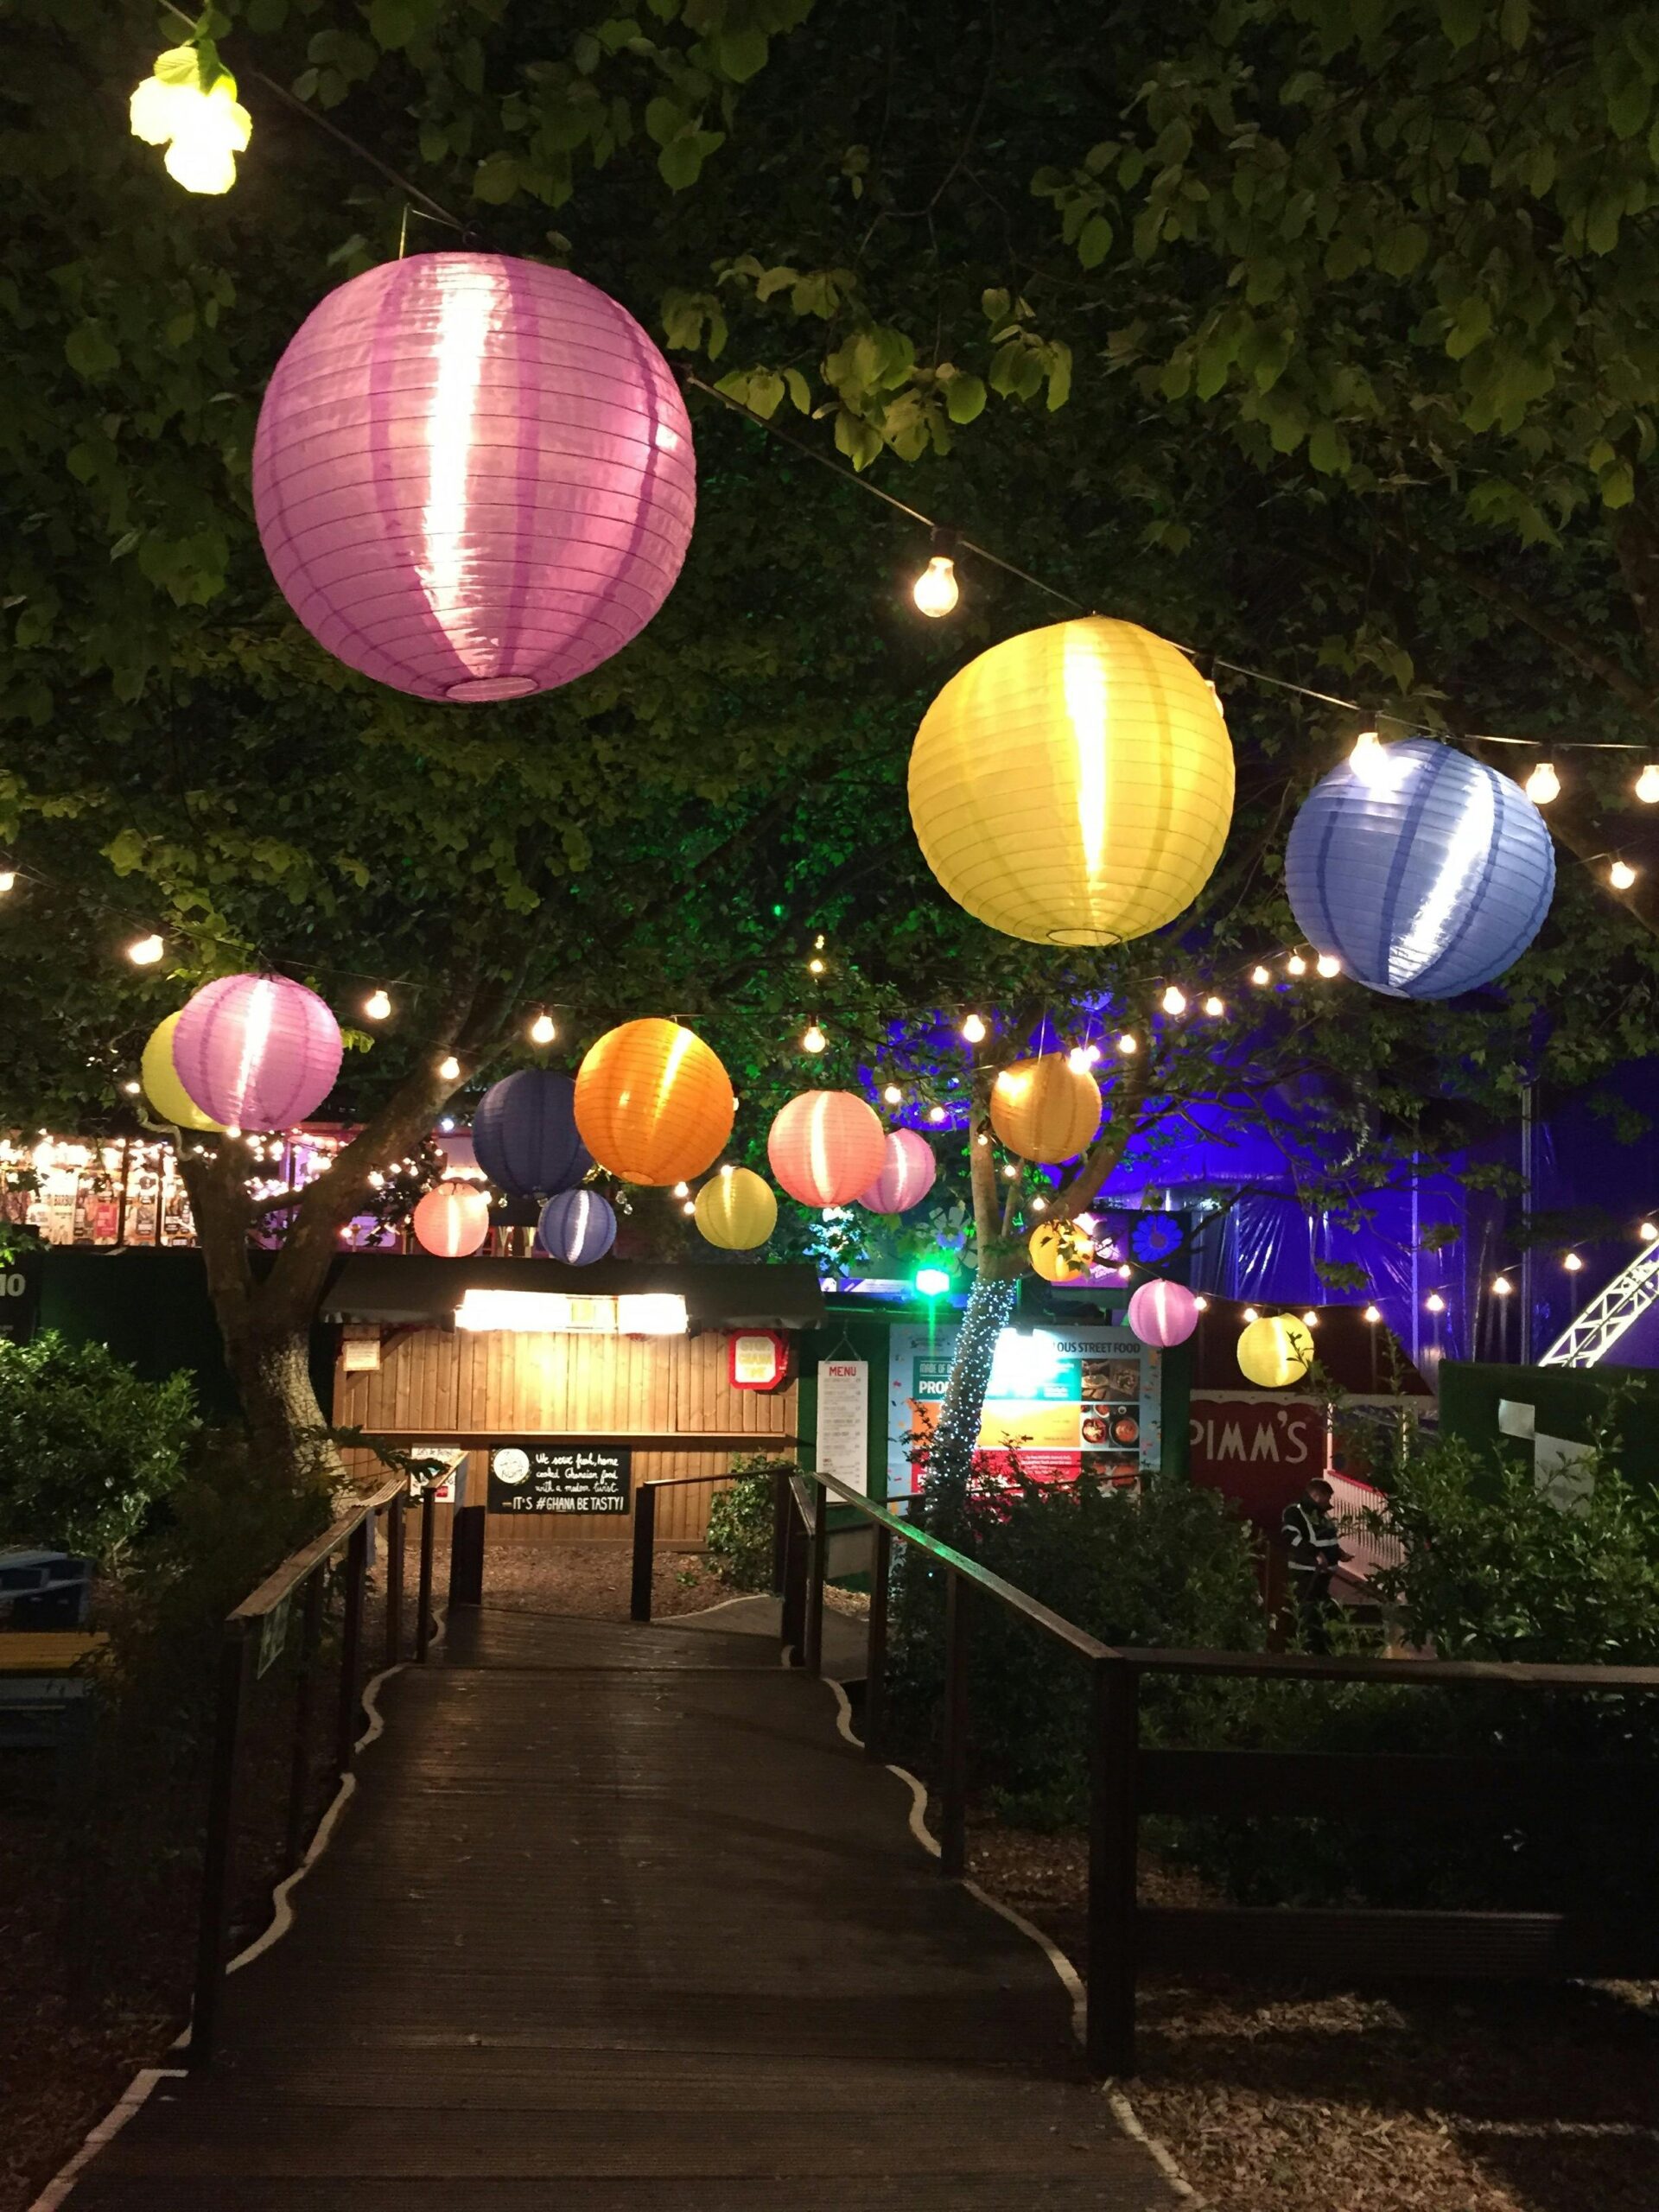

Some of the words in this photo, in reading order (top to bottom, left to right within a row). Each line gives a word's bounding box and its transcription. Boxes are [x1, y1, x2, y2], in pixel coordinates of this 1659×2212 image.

[1052, 1341, 1077, 1353] OUS
[1078, 1342, 1112, 1353] STREET
[1114, 1342, 1141, 1354] FOOD
[829, 1367, 856, 1376] MENU
[1190, 1410, 1307, 1463] PIMM'S
[536, 1452, 550, 1465] We
[597, 1453, 619, 1466] home
[600, 1469, 618, 1484] food
[535, 1480, 555, 1492] with
[536, 1497, 575, 1510] #GHANA
[576, 1497, 589, 1510] BE
